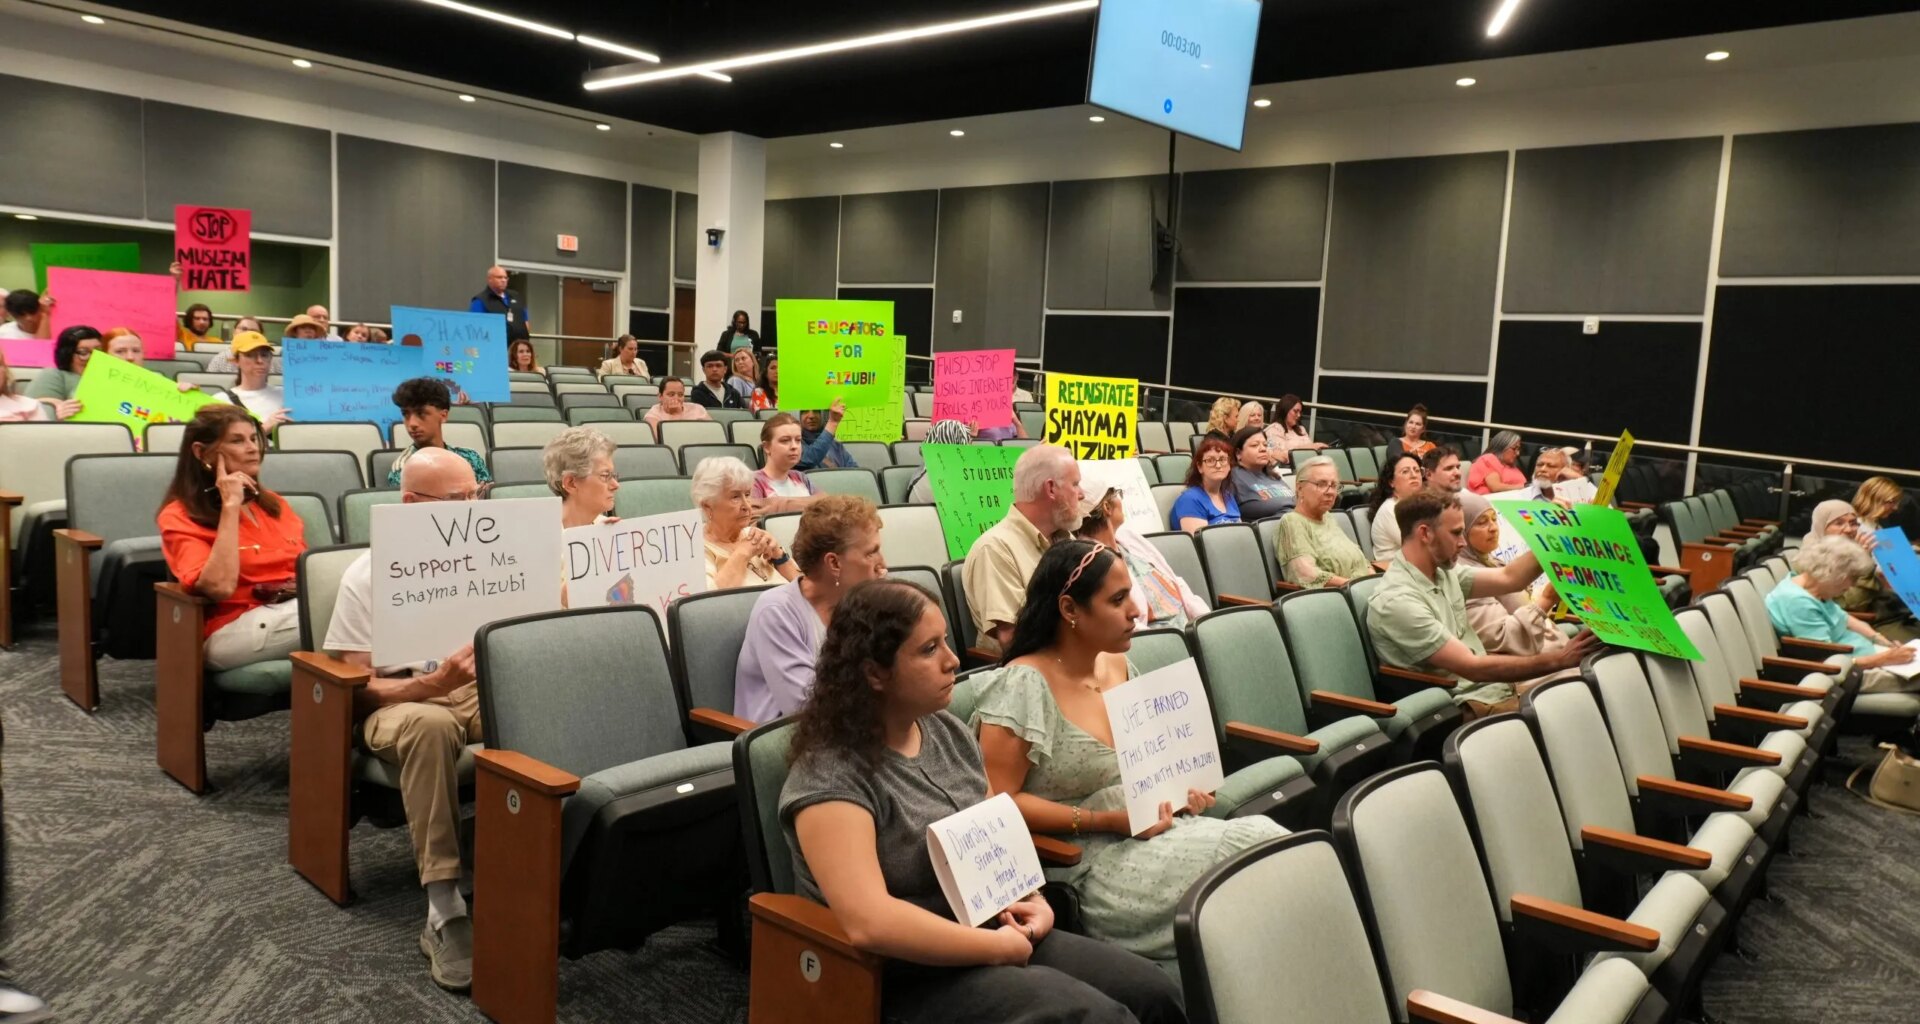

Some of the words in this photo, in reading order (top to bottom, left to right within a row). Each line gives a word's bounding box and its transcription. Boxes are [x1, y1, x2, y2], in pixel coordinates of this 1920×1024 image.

[1161, 30, 1201, 59] 00:03:00
[196, 213, 230, 239] STOP
[177, 247, 247, 268] MUSLIM
[187, 268, 246, 290] HATE
[807, 320, 885, 337] EDUCATORS
[834, 344, 863, 358] FOR
[971, 353, 1000, 374] STOP
[967, 376, 1013, 395] INTERNET
[1058, 380, 1135, 407] REINSTATE
[970, 399, 983, 414] AS
[984, 395, 1011, 411] YOUR
[1048, 408, 1127, 444] SHAYMA
[962, 466, 1015, 481] STUDENTS
[978, 494, 1001, 509] FOR
[430, 507, 501, 547] We
[1517, 509, 1582, 527] FIGHT
[568, 521, 698, 581] DIVERSITY
[1535, 533, 1636, 566] IGNORANCE
[390, 553, 477, 579] Support
[490, 551, 518, 568] Ms.
[1550, 561, 1626, 594] PROMOTE
[391, 584, 459, 607] Shayma
[466, 572, 526, 597] Alzubi
[1121, 701, 1144, 734] SHE
[1144, 690, 1189, 719] EARNED
[1121, 746, 1144, 770] THIS
[1175, 722, 1194, 741] WE
[1131, 775, 1154, 799] STAND
[1154, 765, 1173, 785] WITH
[1193, 751, 1217, 769] ALZUBI
[946, 819, 993, 861] Diversity
[998, 817, 1005, 828] a
[806, 958, 815, 973] F
